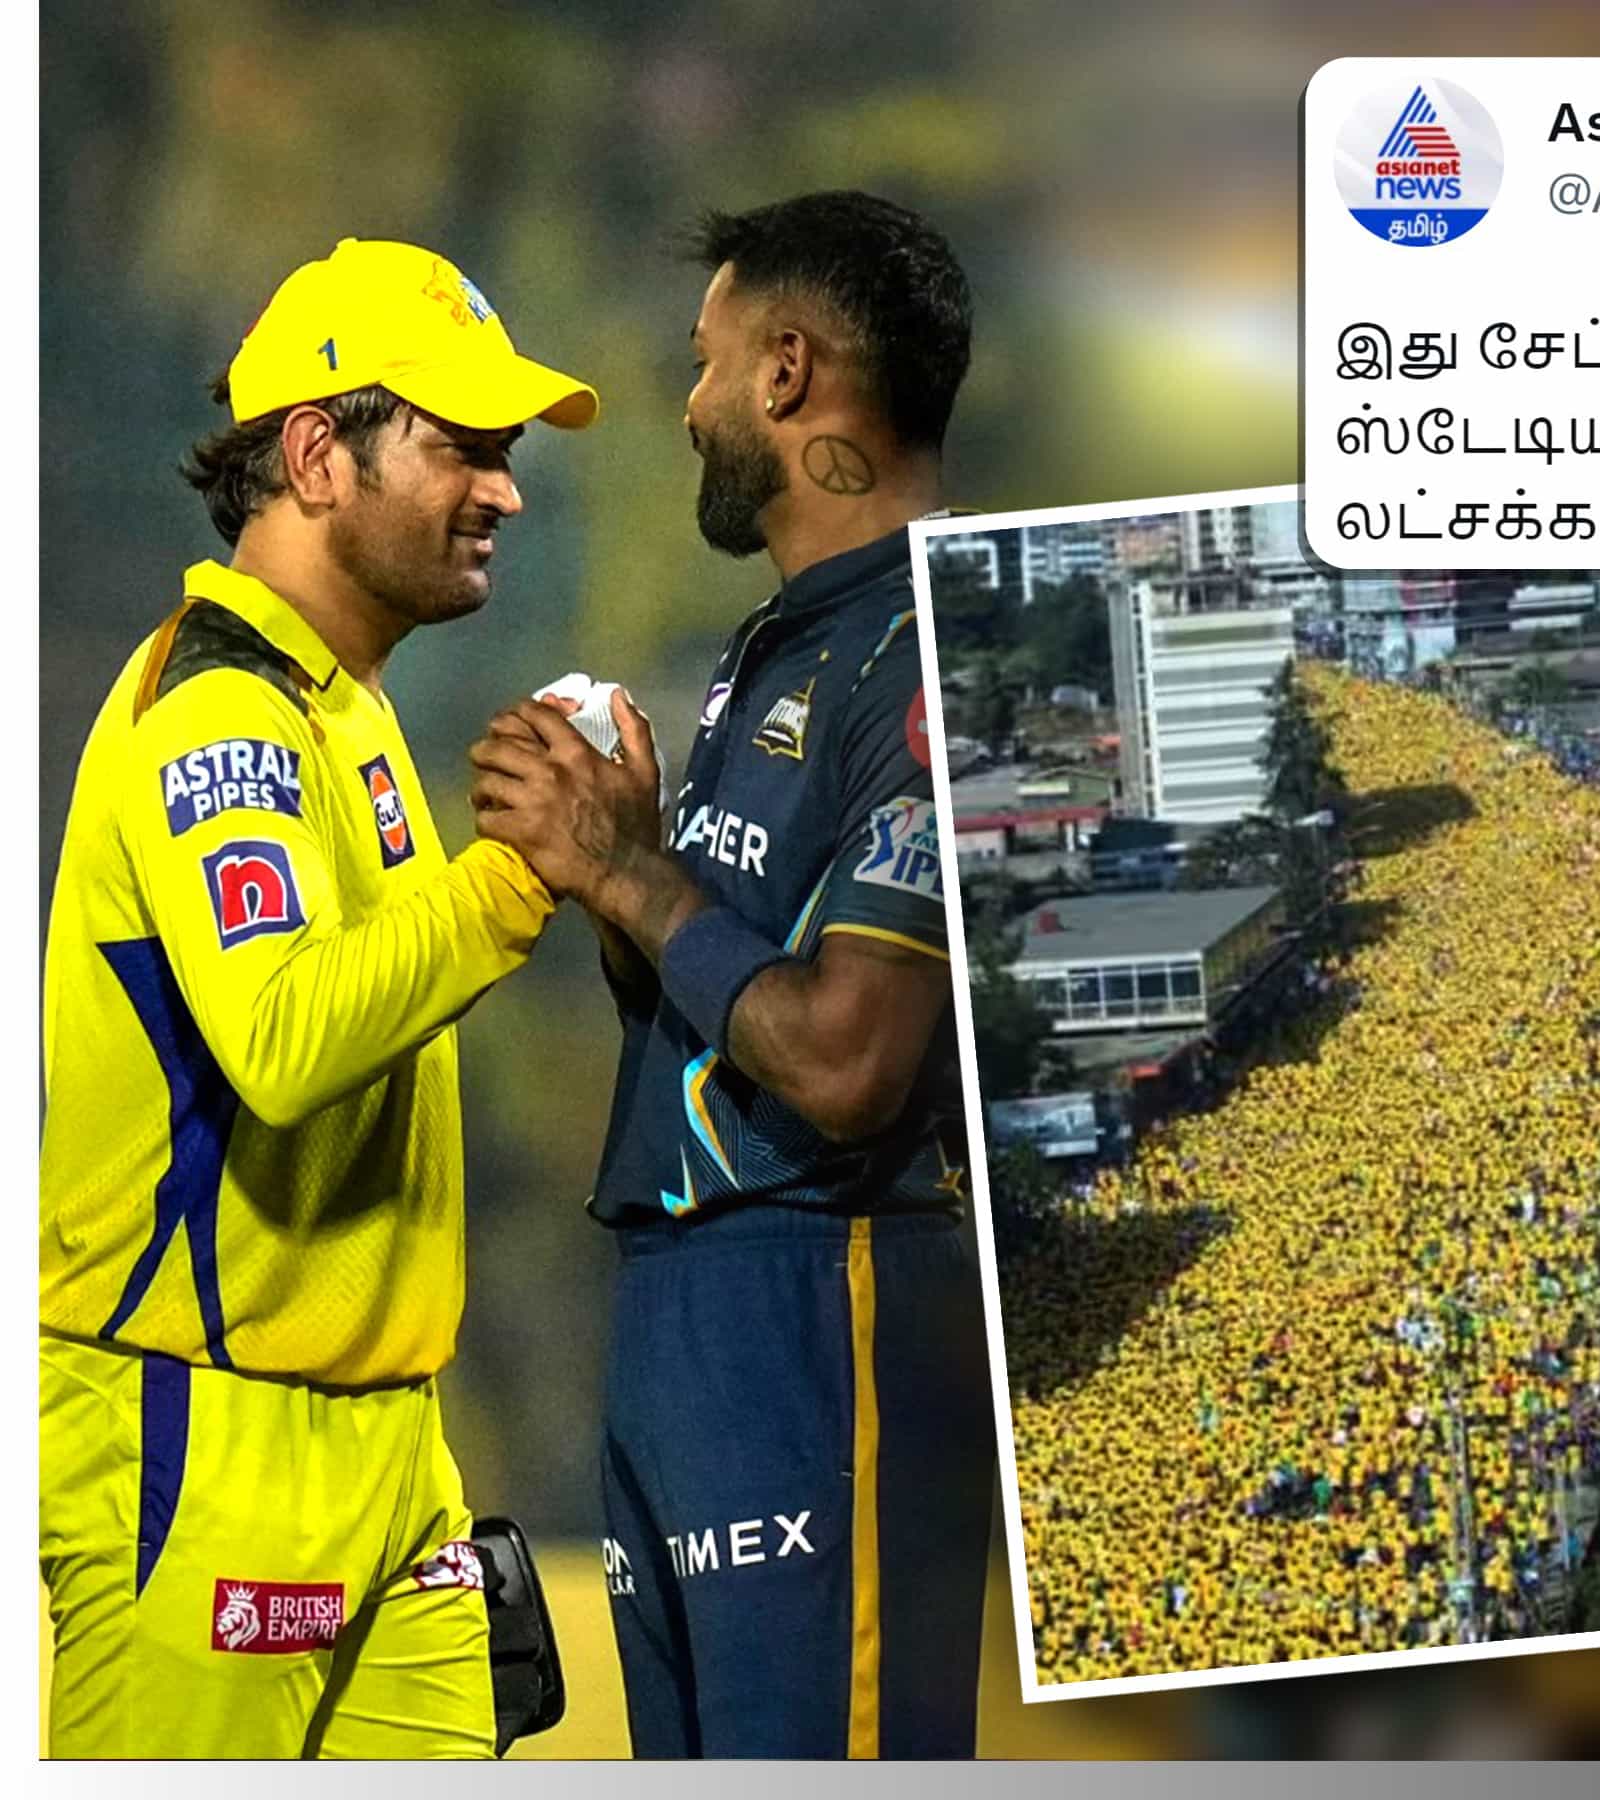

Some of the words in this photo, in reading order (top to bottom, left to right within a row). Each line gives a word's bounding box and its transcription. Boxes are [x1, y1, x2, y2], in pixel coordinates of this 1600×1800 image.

[317, 337, 337, 371] 1
[165, 740, 301, 807] ASTRAL
[193, 782, 276, 821] PIPES
[666, 1510, 816, 1578] TIMEX
[269, 1595, 342, 1619] BRITISH
